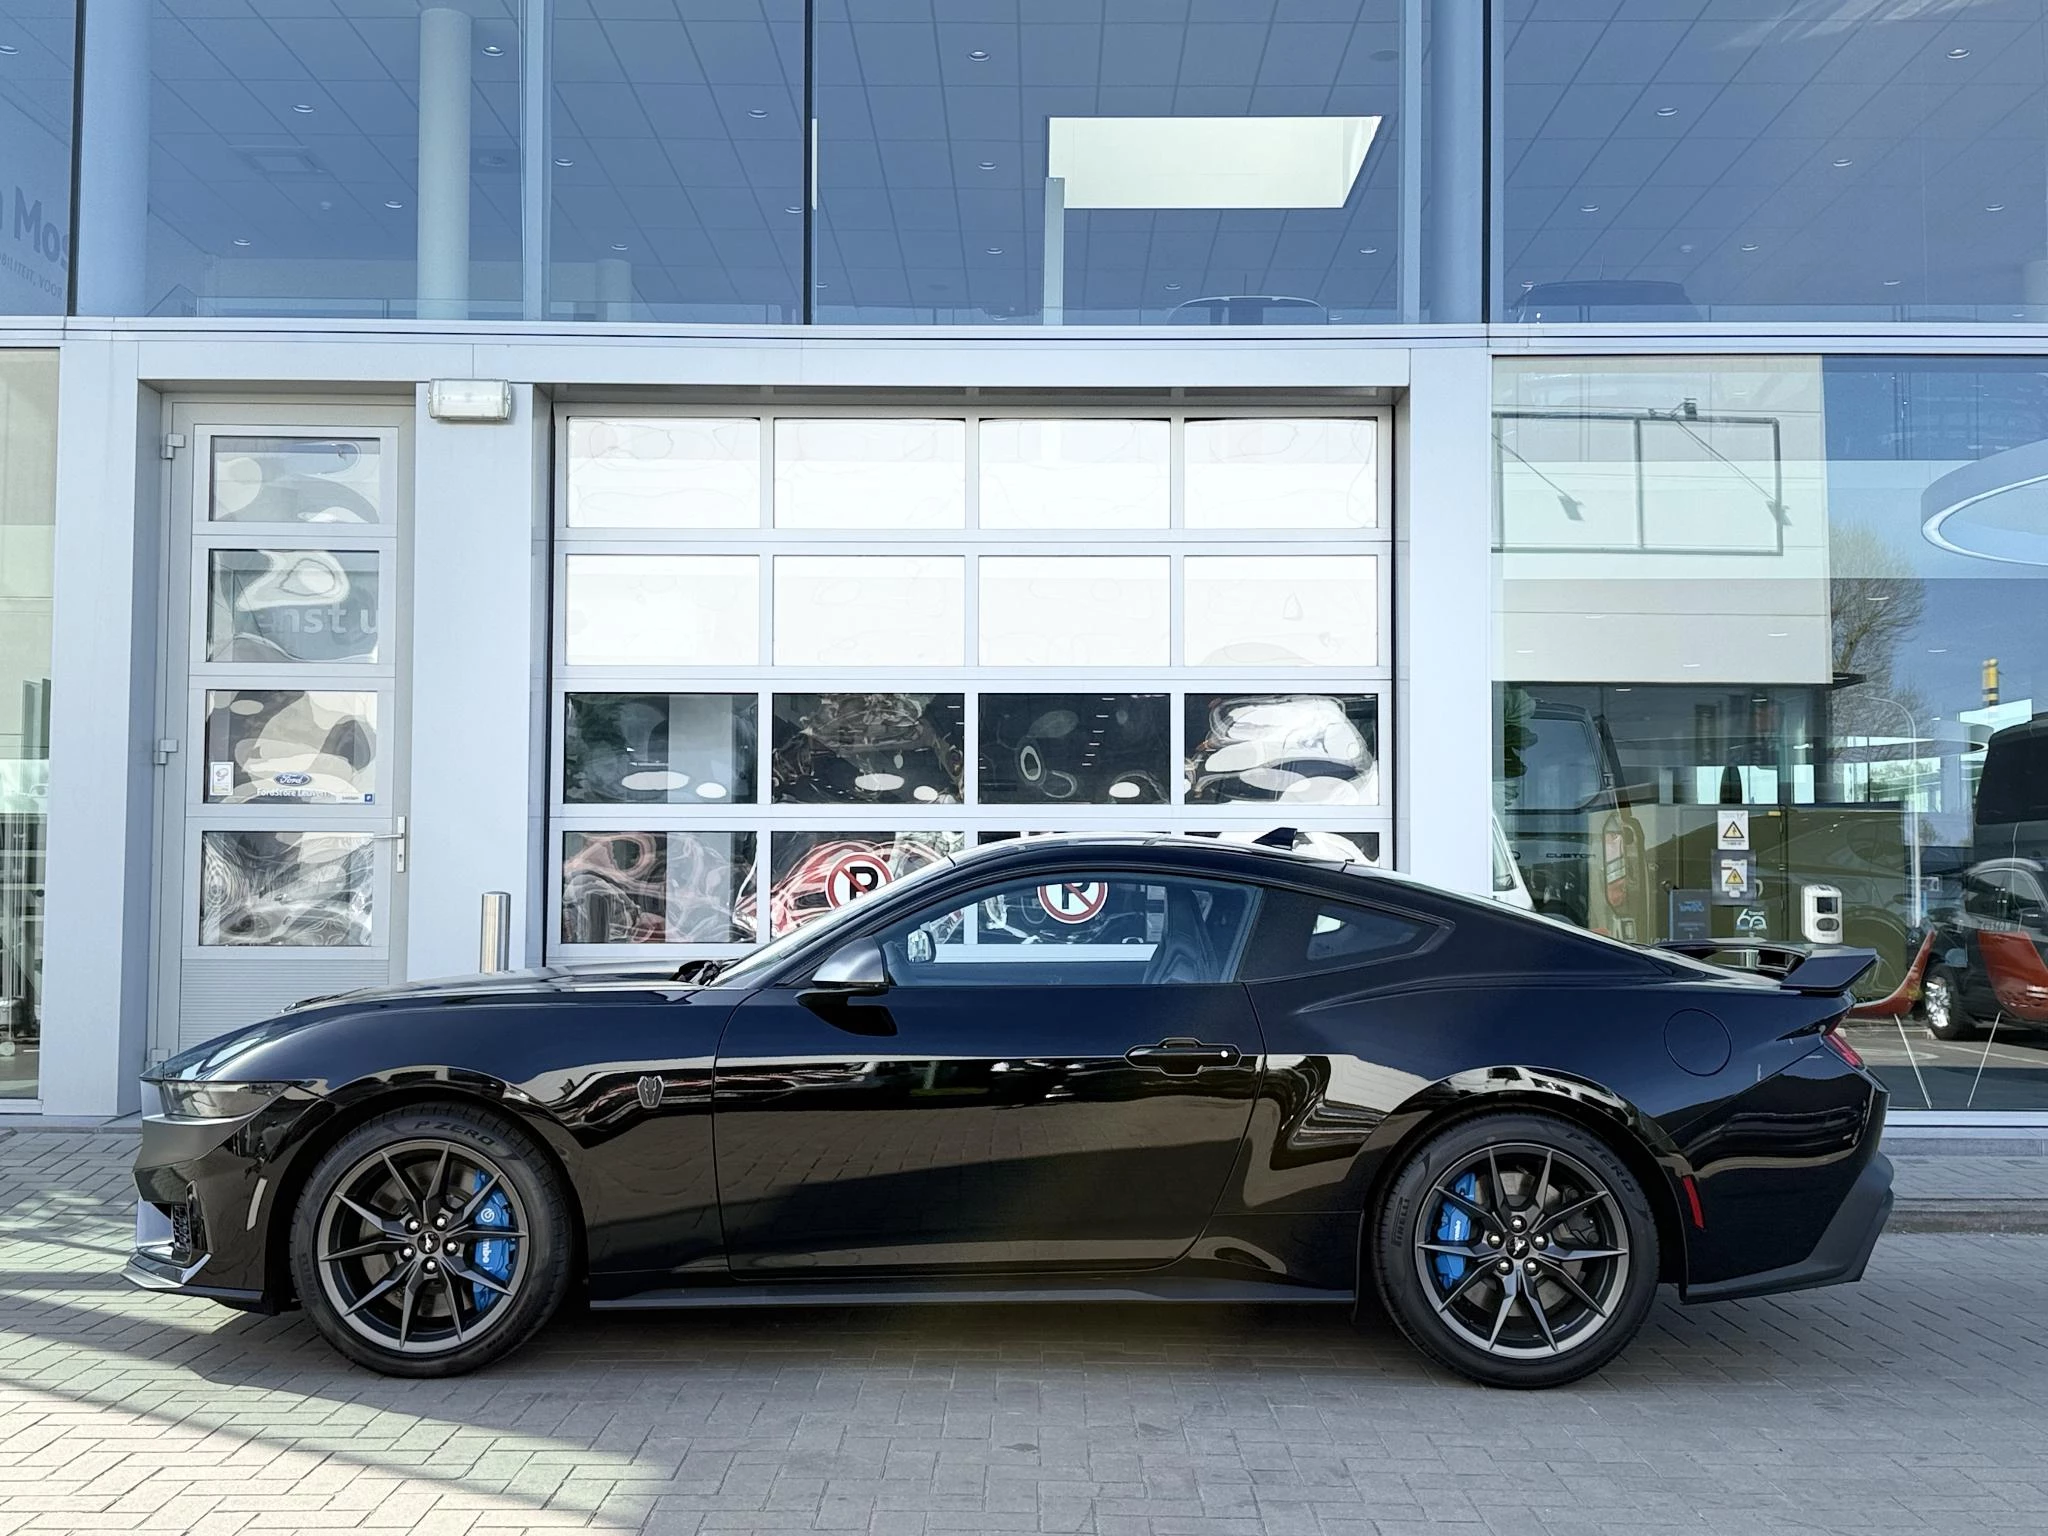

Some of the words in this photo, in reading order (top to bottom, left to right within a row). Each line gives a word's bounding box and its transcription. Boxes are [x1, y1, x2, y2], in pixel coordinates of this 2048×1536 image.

[0, 251, 36, 287] BILITEIT,
[849, 866, 879, 901] P
[433, 1121, 496, 1146] ZERO
[482, 1238, 492, 1264] mbo
